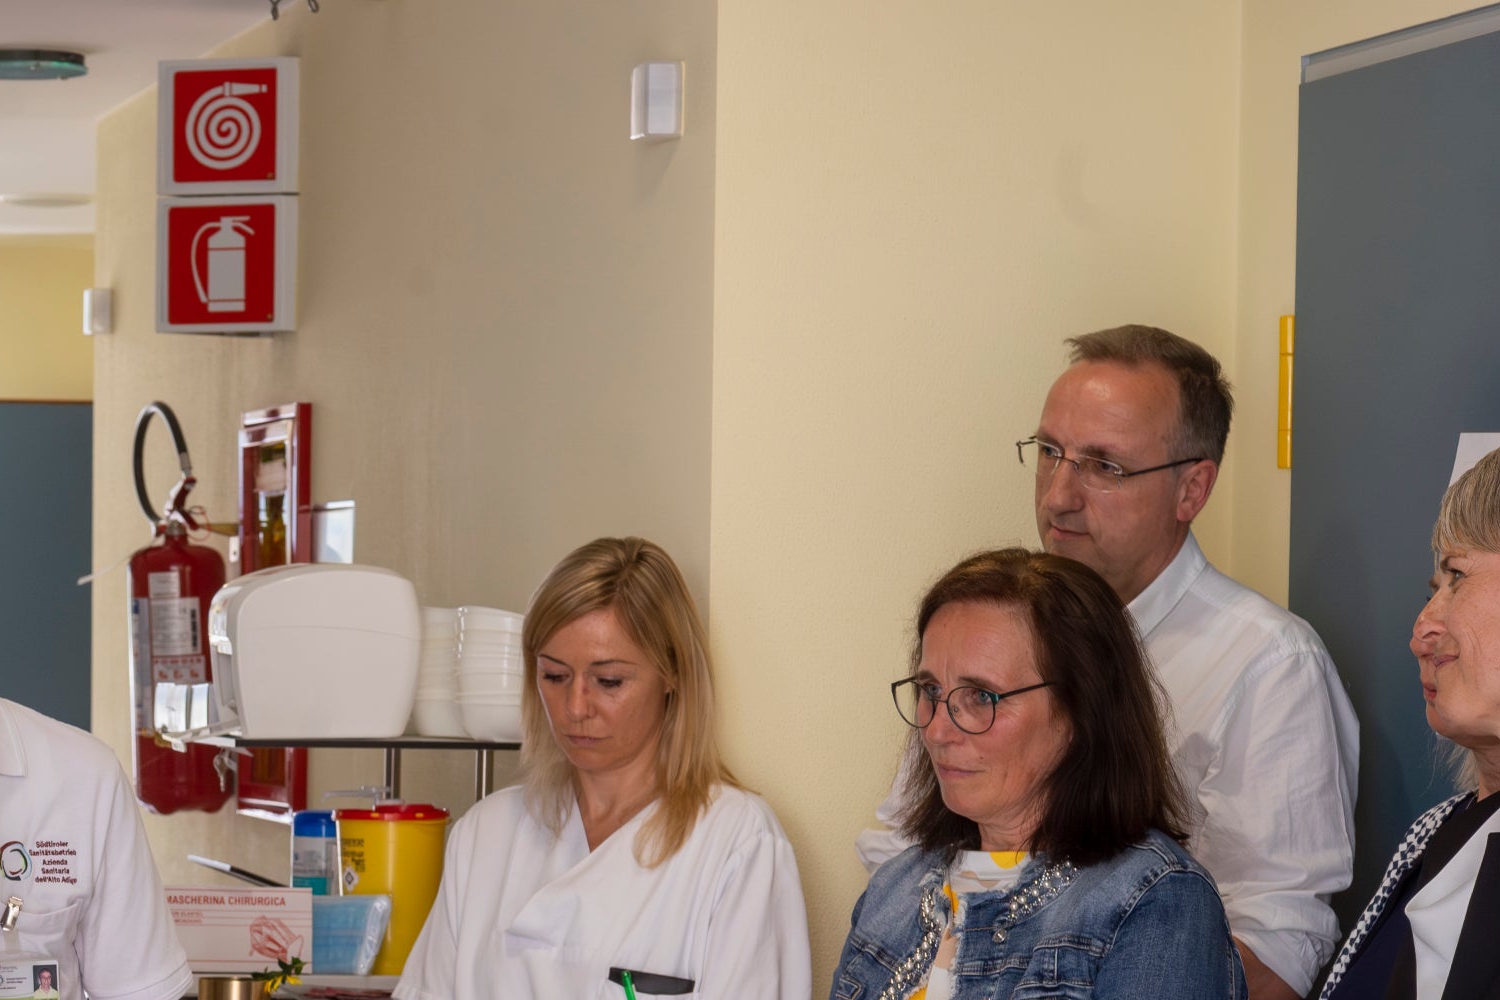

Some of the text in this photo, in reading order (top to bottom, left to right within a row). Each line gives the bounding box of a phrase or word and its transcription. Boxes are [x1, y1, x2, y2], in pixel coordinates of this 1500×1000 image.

[29, 848, 76, 856] Sanitätsbetrieb
[61, 876, 77, 885] Adige
[228, 896, 286, 906] CHIRURGICA
